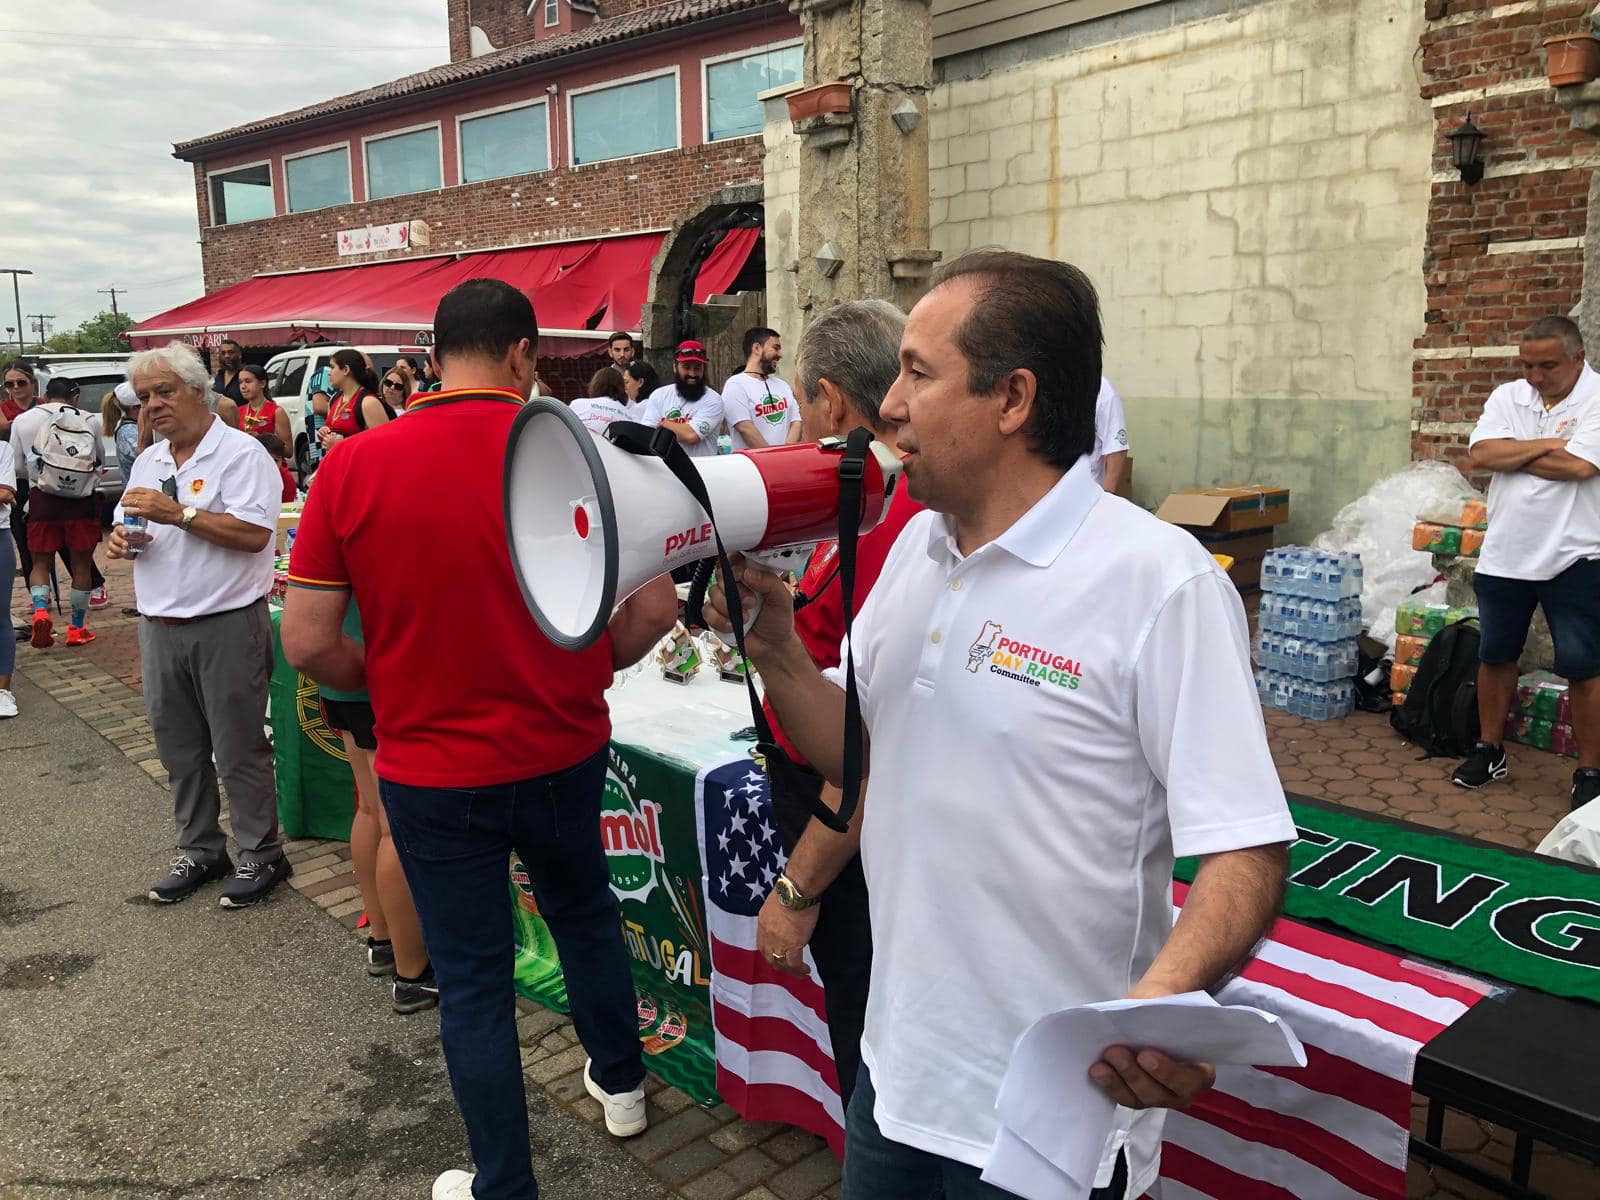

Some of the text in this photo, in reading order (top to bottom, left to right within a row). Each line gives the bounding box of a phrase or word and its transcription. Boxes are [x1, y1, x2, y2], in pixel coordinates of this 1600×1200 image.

[754, 396, 788, 418] Sumol
[665, 522, 712, 556] PYLE
[990, 664, 1041, 687] Committee
[992, 651, 1080, 690] DAY RACES
[997, 637, 1083, 677] PORTUGAL
[608, 747, 637, 789] EIRA
[604, 783, 625, 799] NAL
[599, 804, 662, 858] mol
[621, 919, 711, 987] RTUGAL
